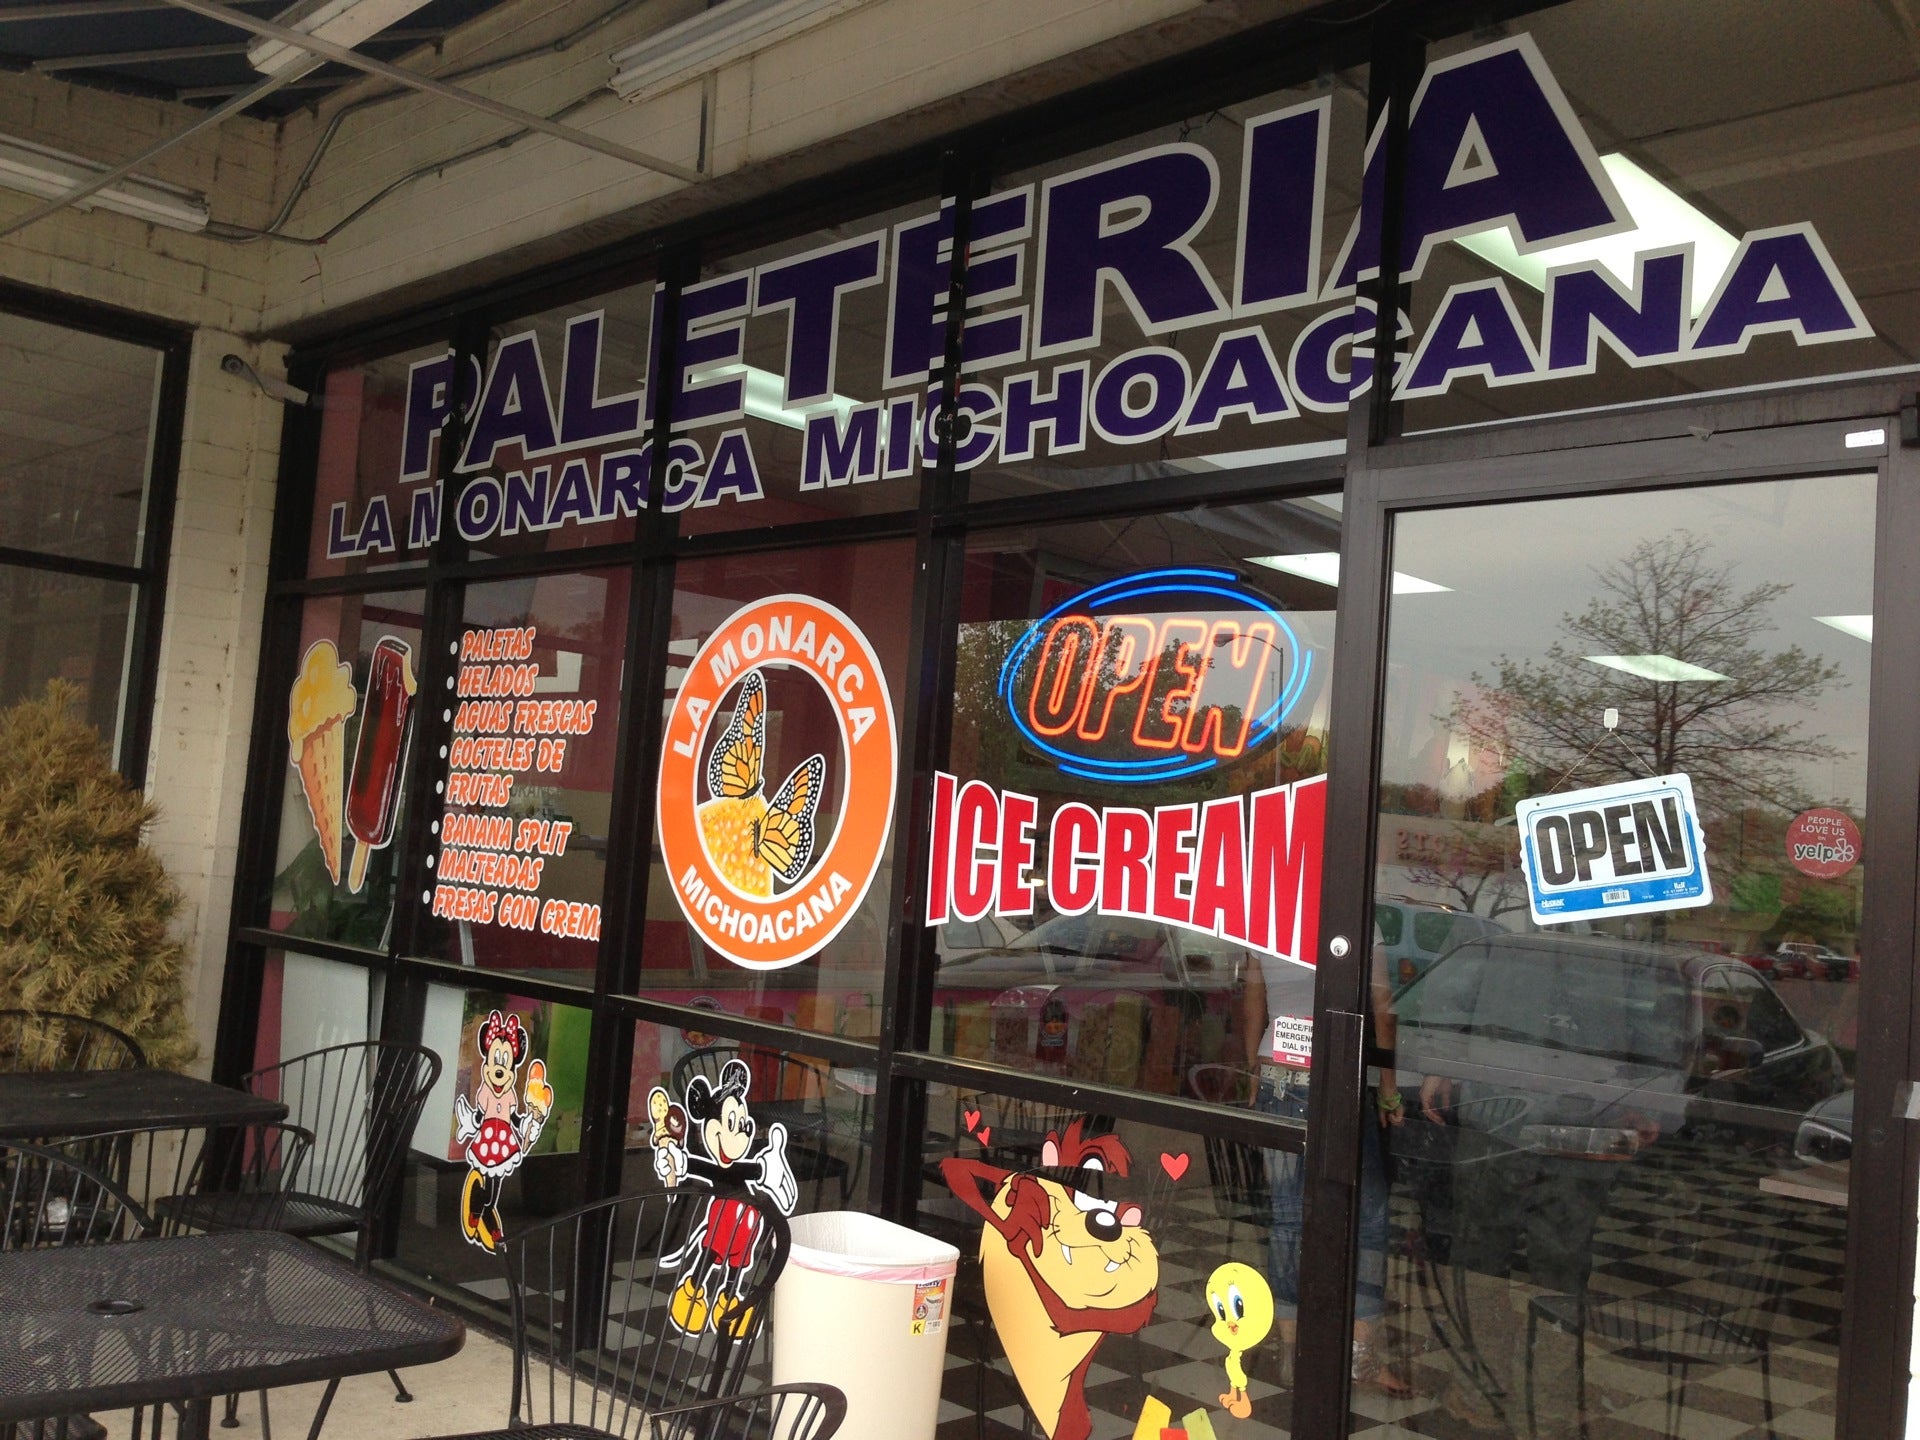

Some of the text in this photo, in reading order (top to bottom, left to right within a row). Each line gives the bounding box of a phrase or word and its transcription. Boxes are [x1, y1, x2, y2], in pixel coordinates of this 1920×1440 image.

[399, 32, 1638, 484] PALETERIA
[326, 221, 1875, 559] LA MONARCA MICHOACANA
[461, 627, 536, 661] PALETAS
[457, 663, 539, 697] HELADOS
[673, 615, 877, 758] LA MONARCA
[1029, 614, 1276, 758] OPEN
[454, 700, 597, 736] AGUAS FRESCAS
[450, 737, 566, 772] COCTELES DE
[447, 772, 513, 807] FRUTAS
[441, 813, 572, 856] BANANA SPLIT
[1801, 824, 1846, 836] LOVE US
[1807, 816, 1842, 826] PEOPLE
[1536, 796, 1687, 886] OPEN
[1794, 843, 1834, 864] yelp
[437, 848, 543, 891] MALTEADAS
[925, 770, 1328, 972] ICE CREAM
[432, 885, 601, 942] FRESAS CON CREM
[679, 864, 853, 945] MICHOACANA
[1275, 1031, 1312, 1042] EMERGEN
[1282, 1042, 1312, 1053] DIAL 911
[913, 1323, 921, 1334] K
